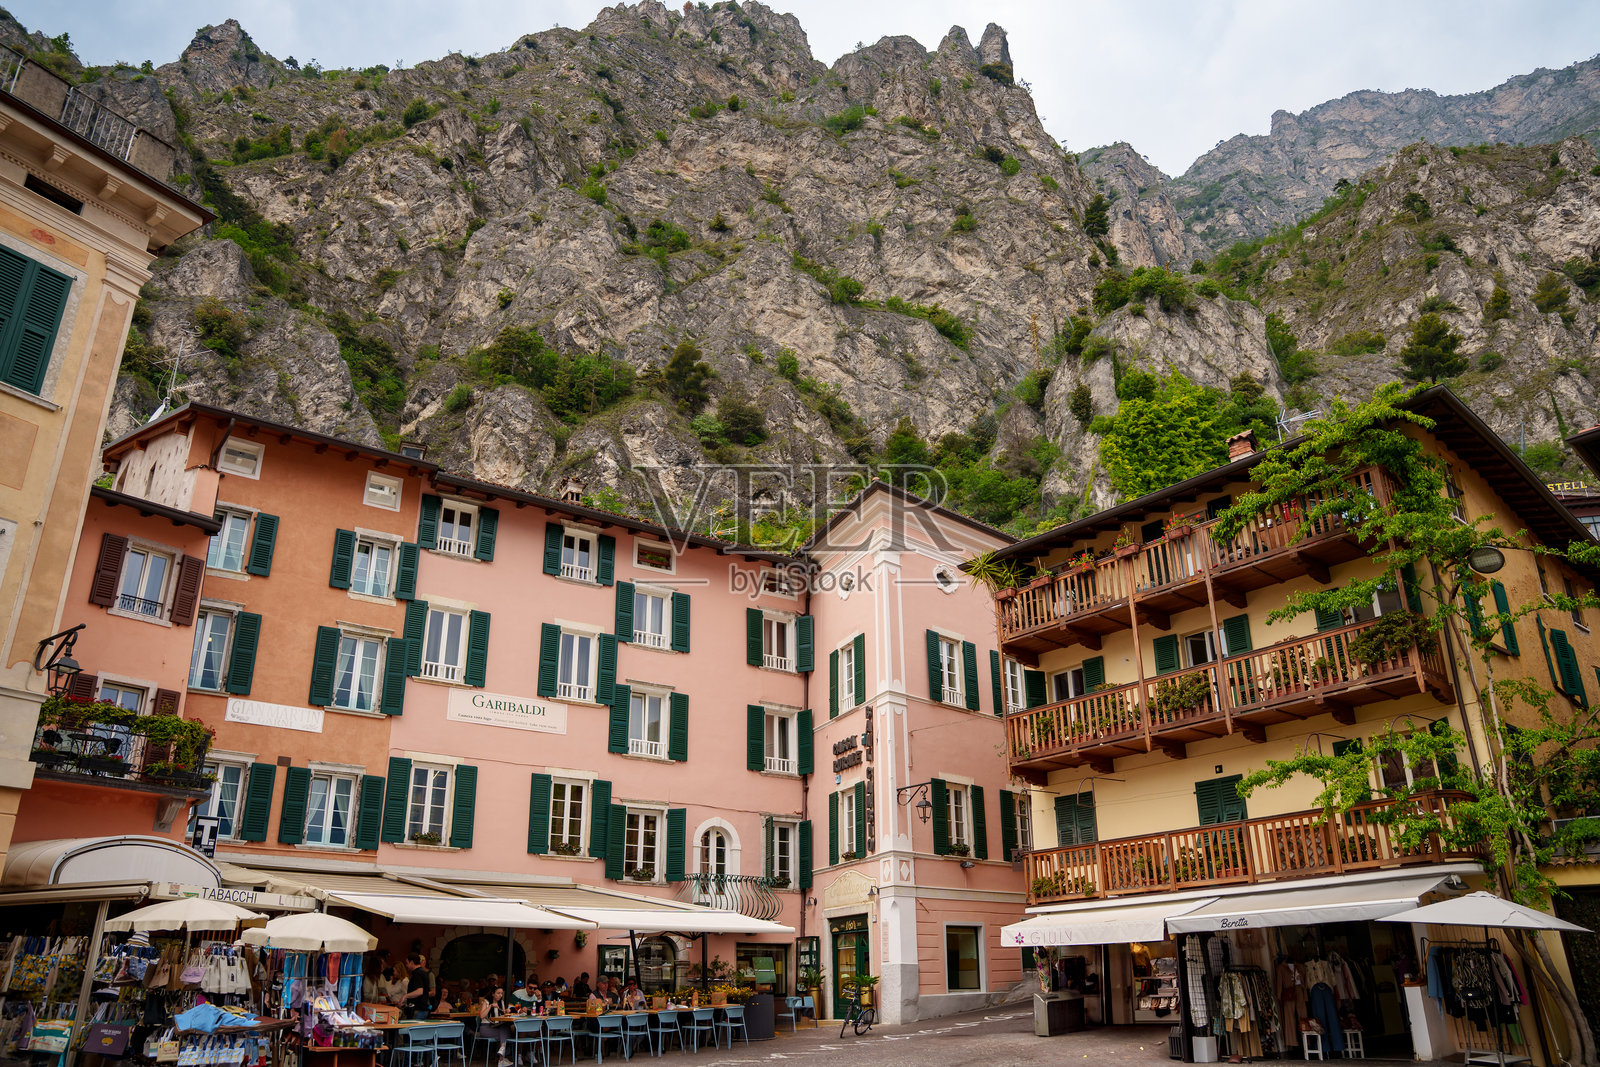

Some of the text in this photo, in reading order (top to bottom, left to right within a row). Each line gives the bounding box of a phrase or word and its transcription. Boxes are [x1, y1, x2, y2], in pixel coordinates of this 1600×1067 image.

[472, 694, 546, 716] GARIBALDI
[198, 818, 219, 845] T
[202, 887, 258, 904] TABACCHI
[1221, 917, 1249, 929] Beretta
